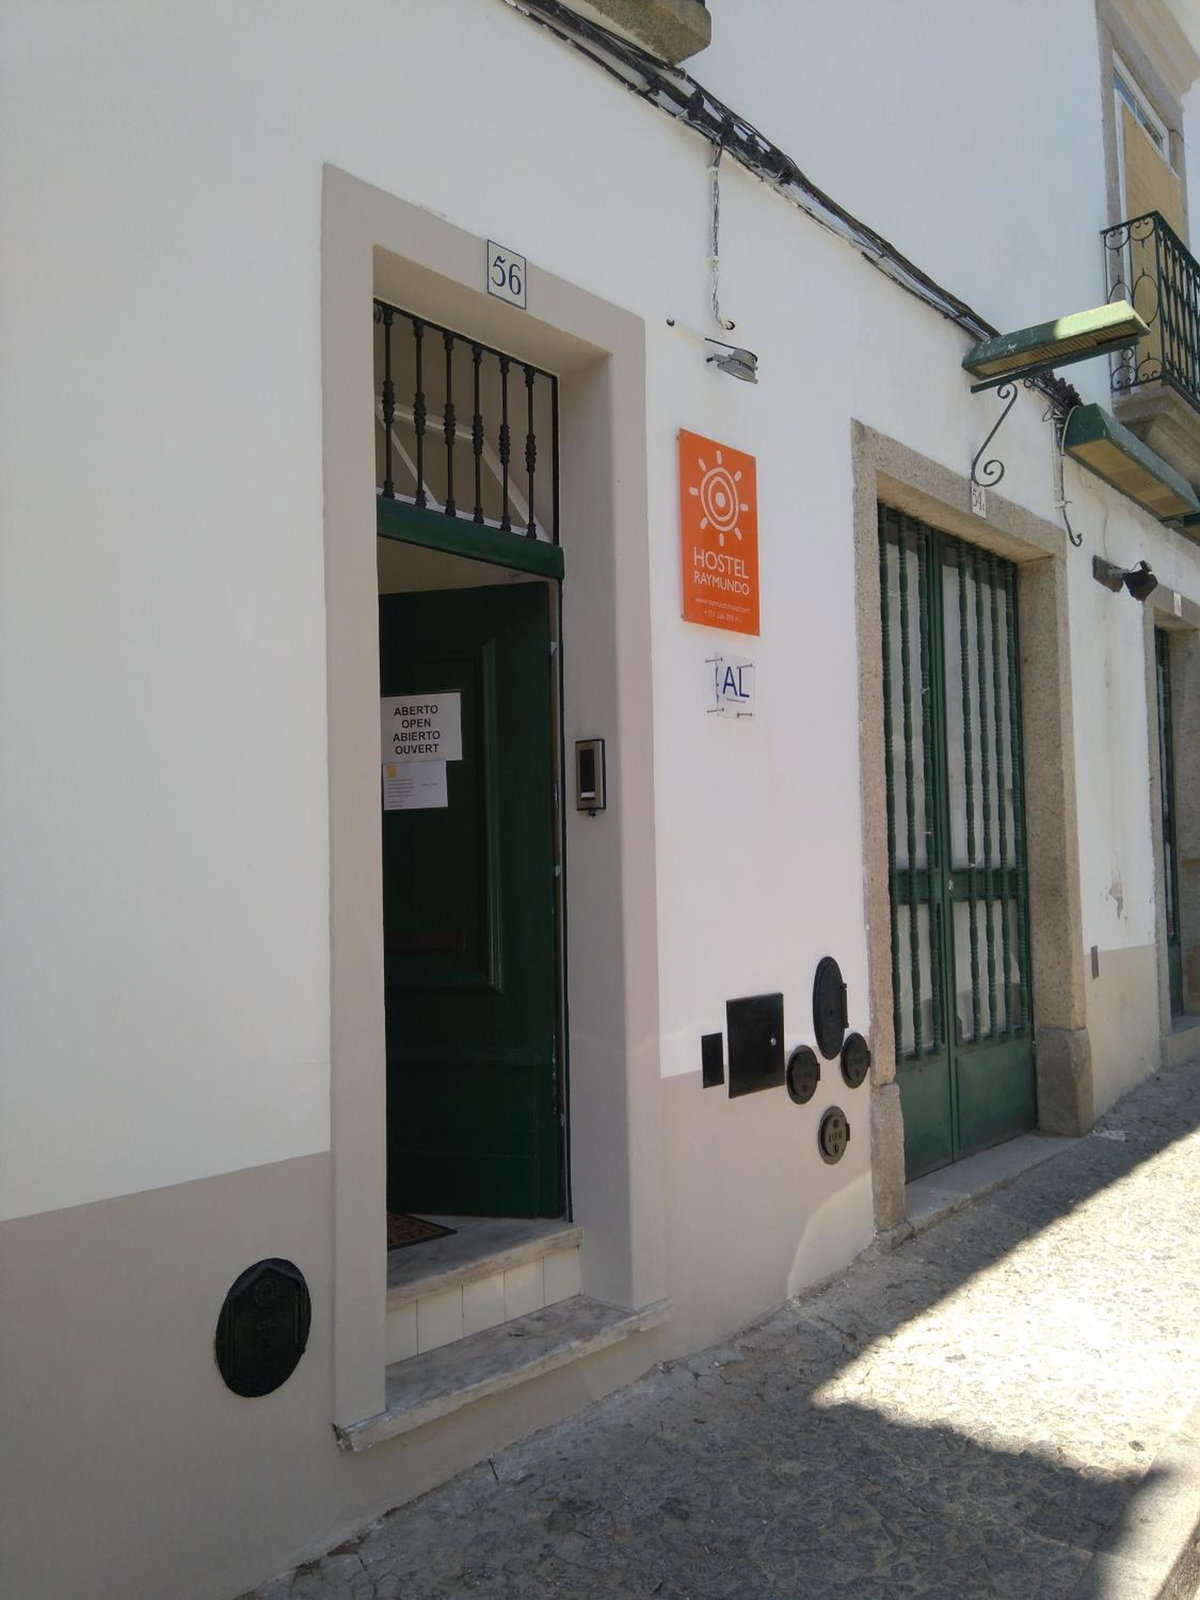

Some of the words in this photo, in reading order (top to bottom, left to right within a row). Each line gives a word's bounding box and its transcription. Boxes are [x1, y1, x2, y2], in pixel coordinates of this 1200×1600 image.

[491, 255, 522, 295] 56
[693, 546, 750, 579] HOSTEL
[693, 570, 750, 596] RAYMUNDO
[722, 666, 750, 698] AL
[393, 704, 439, 717] ABERTO
[401, 718, 431, 729] OPEN
[392, 730, 441, 742] ABIERTO
[395, 743, 440, 755] OUVERT
